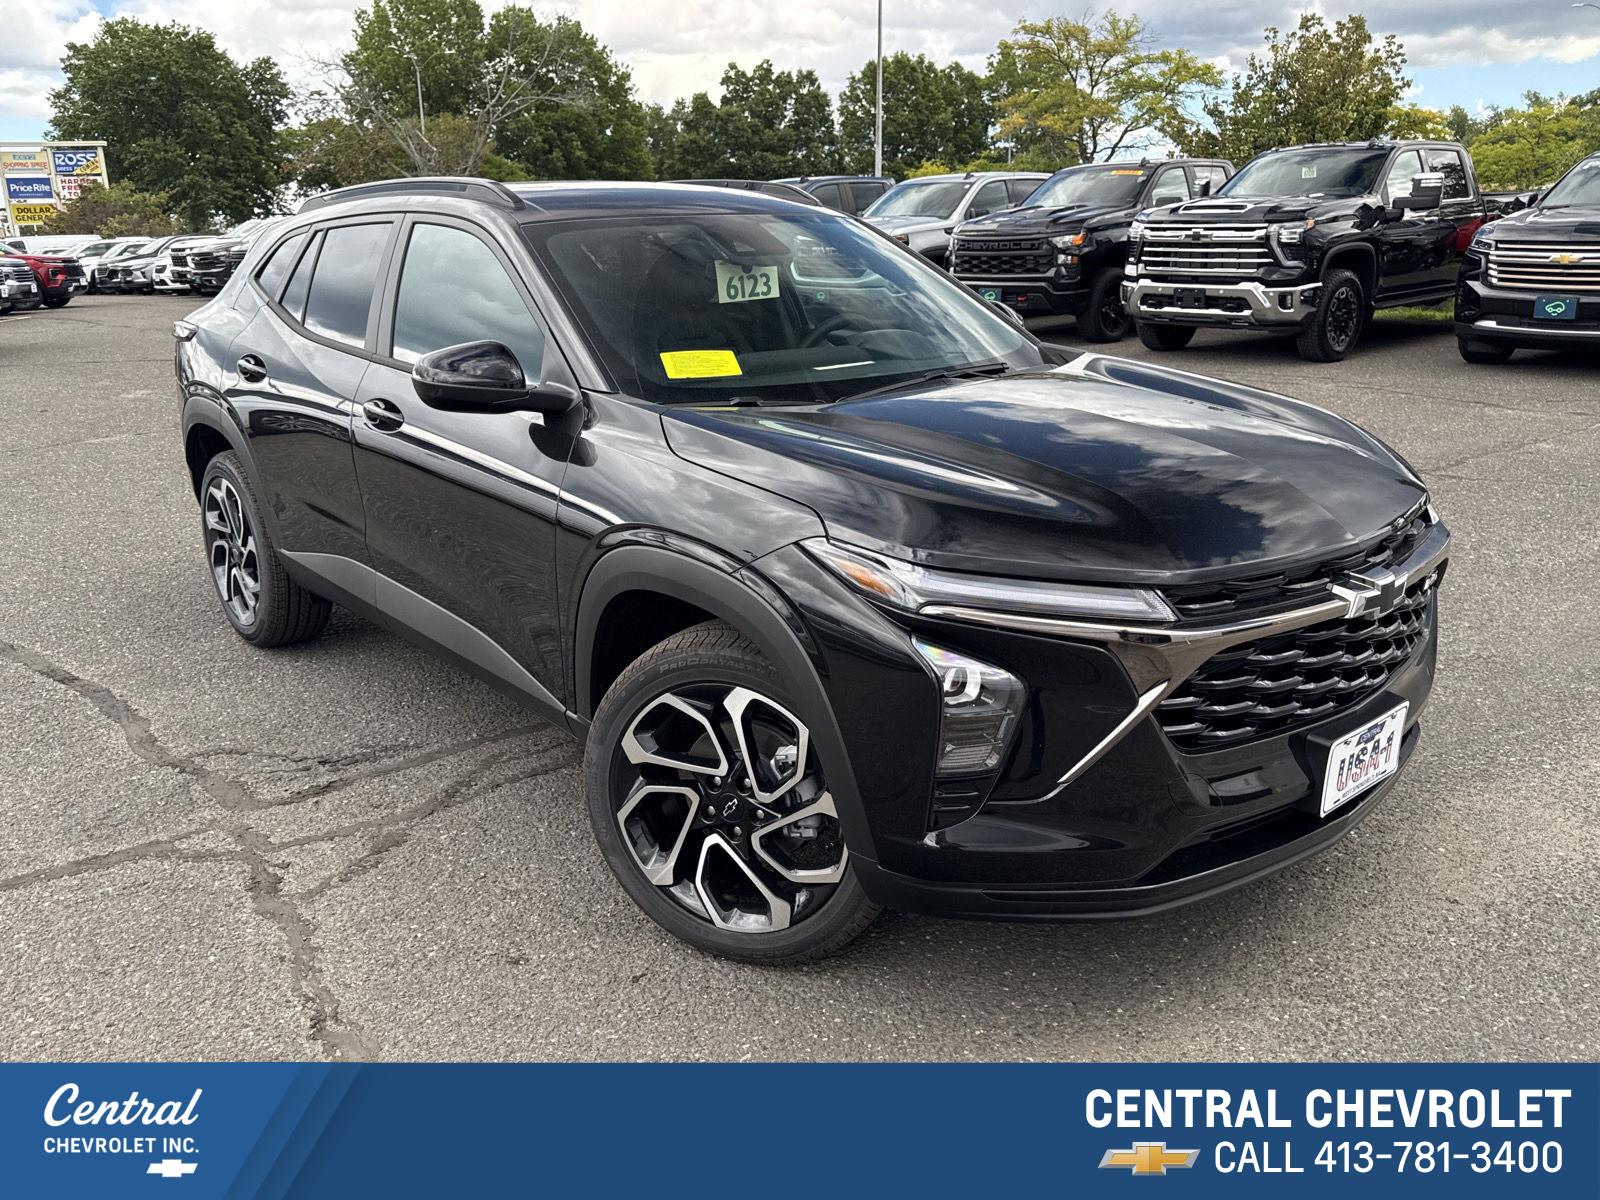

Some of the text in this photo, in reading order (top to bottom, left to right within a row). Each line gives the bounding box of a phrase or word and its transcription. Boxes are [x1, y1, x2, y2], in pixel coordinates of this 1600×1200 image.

[54, 154, 96, 165] ROSS
[10, 183, 51, 192] Price Rite
[15, 214, 50, 222] GENERA
[958, 241, 1039, 249] CHEVROLET
[725, 273, 772, 300] 6123
[1336, 730, 1395, 792] USA-1
